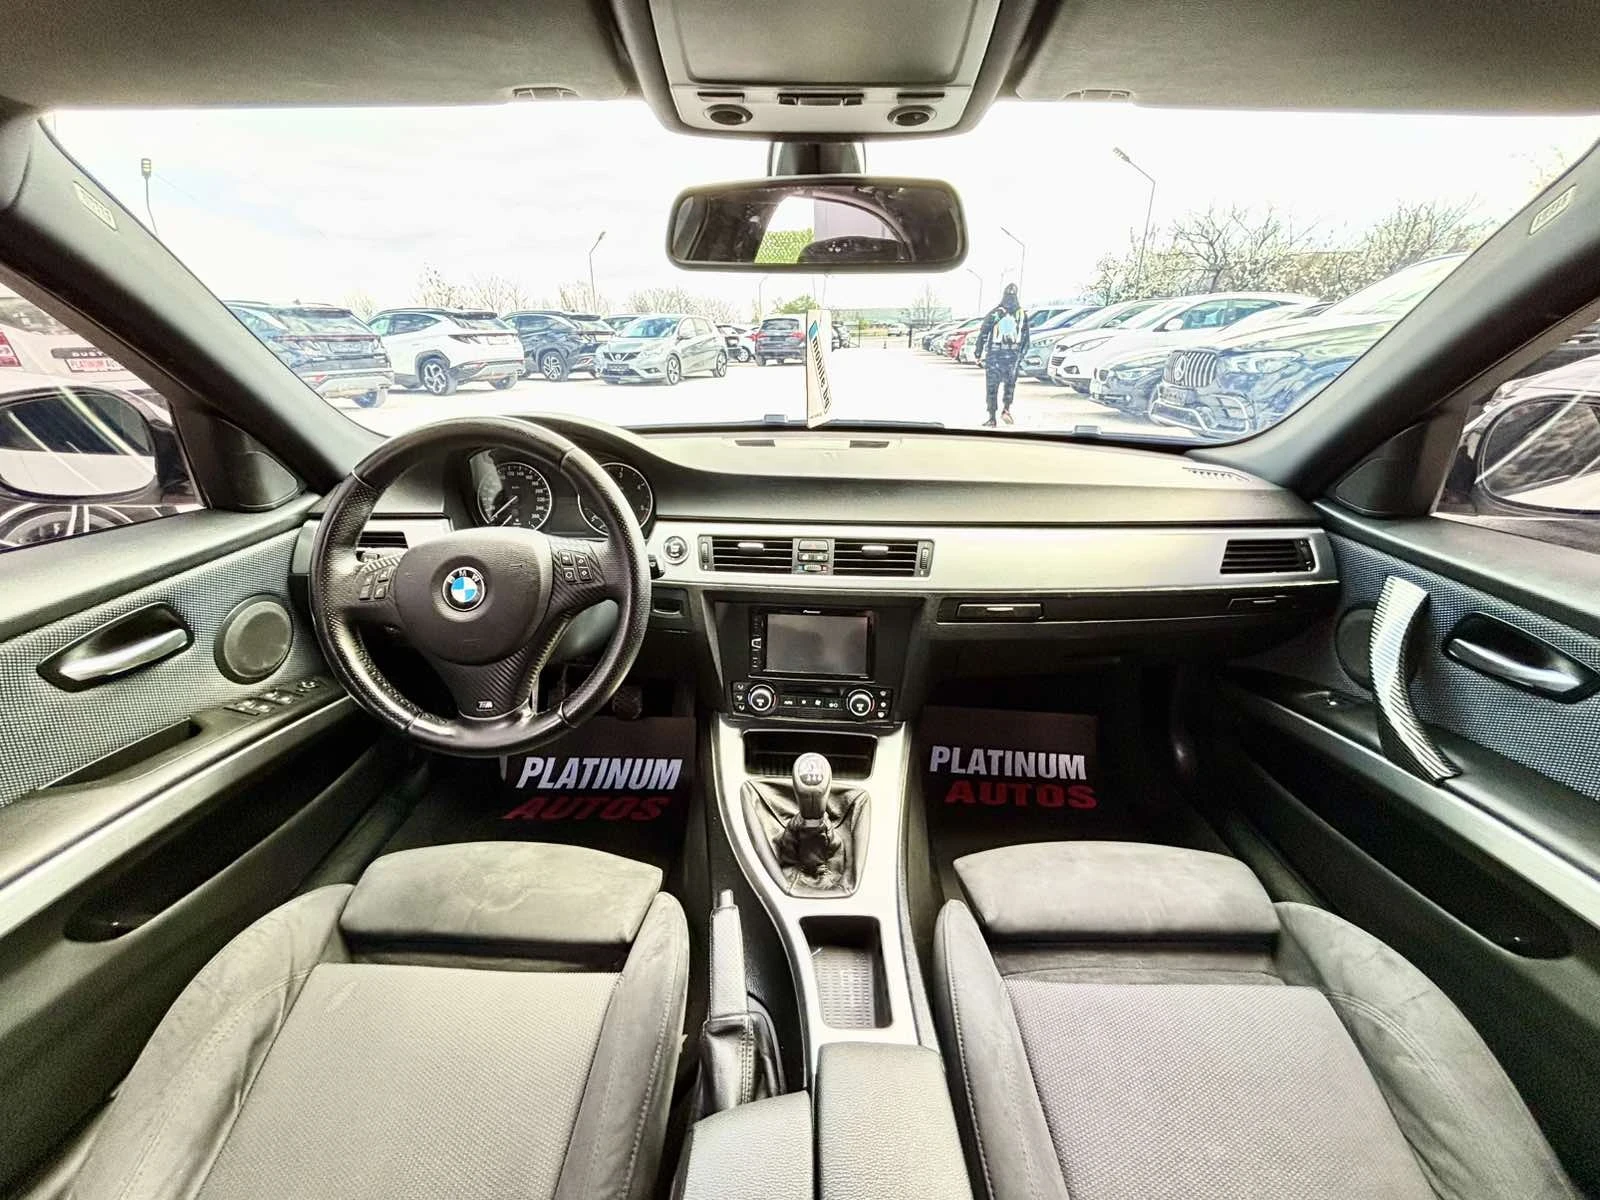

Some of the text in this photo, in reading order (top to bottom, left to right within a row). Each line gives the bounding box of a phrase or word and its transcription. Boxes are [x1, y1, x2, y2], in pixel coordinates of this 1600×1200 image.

[515, 757, 683, 790] PLATINUM
[930, 745, 1087, 780] PLATINUM
[501, 796, 672, 820] AUTOS
[945, 780, 1097, 809] AUTOS
